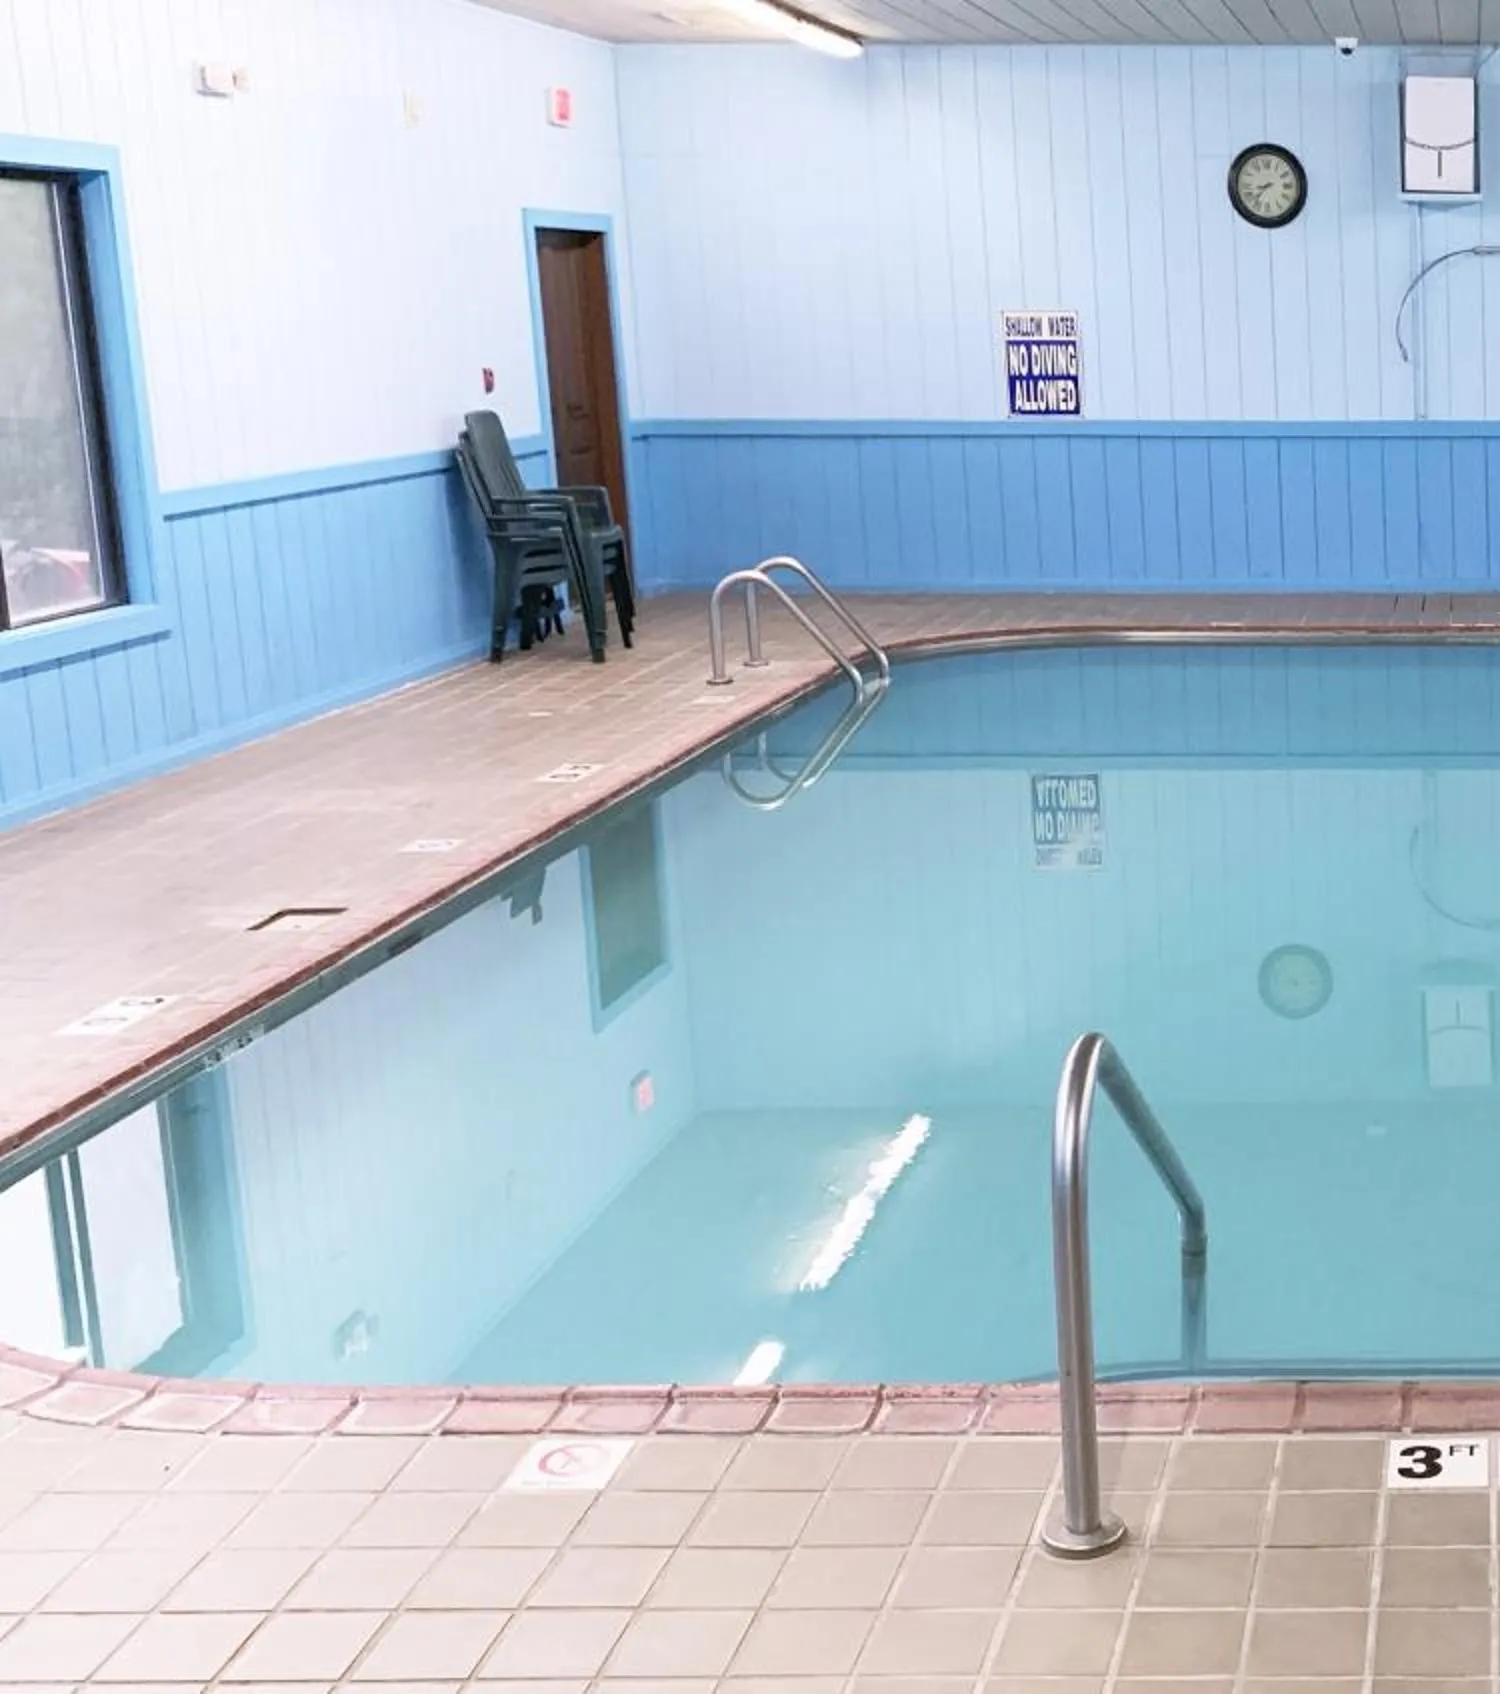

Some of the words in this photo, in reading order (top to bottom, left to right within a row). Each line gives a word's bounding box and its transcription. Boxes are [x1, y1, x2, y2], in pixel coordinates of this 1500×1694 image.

[1009, 344, 1028, 376] NO
[1031, 344, 1077, 376] DIVING
[1015, 380, 1077, 411] ALLOWED
[1398, 1445, 1443, 1479] 3
[1450, 1444, 1478, 1456] FT
